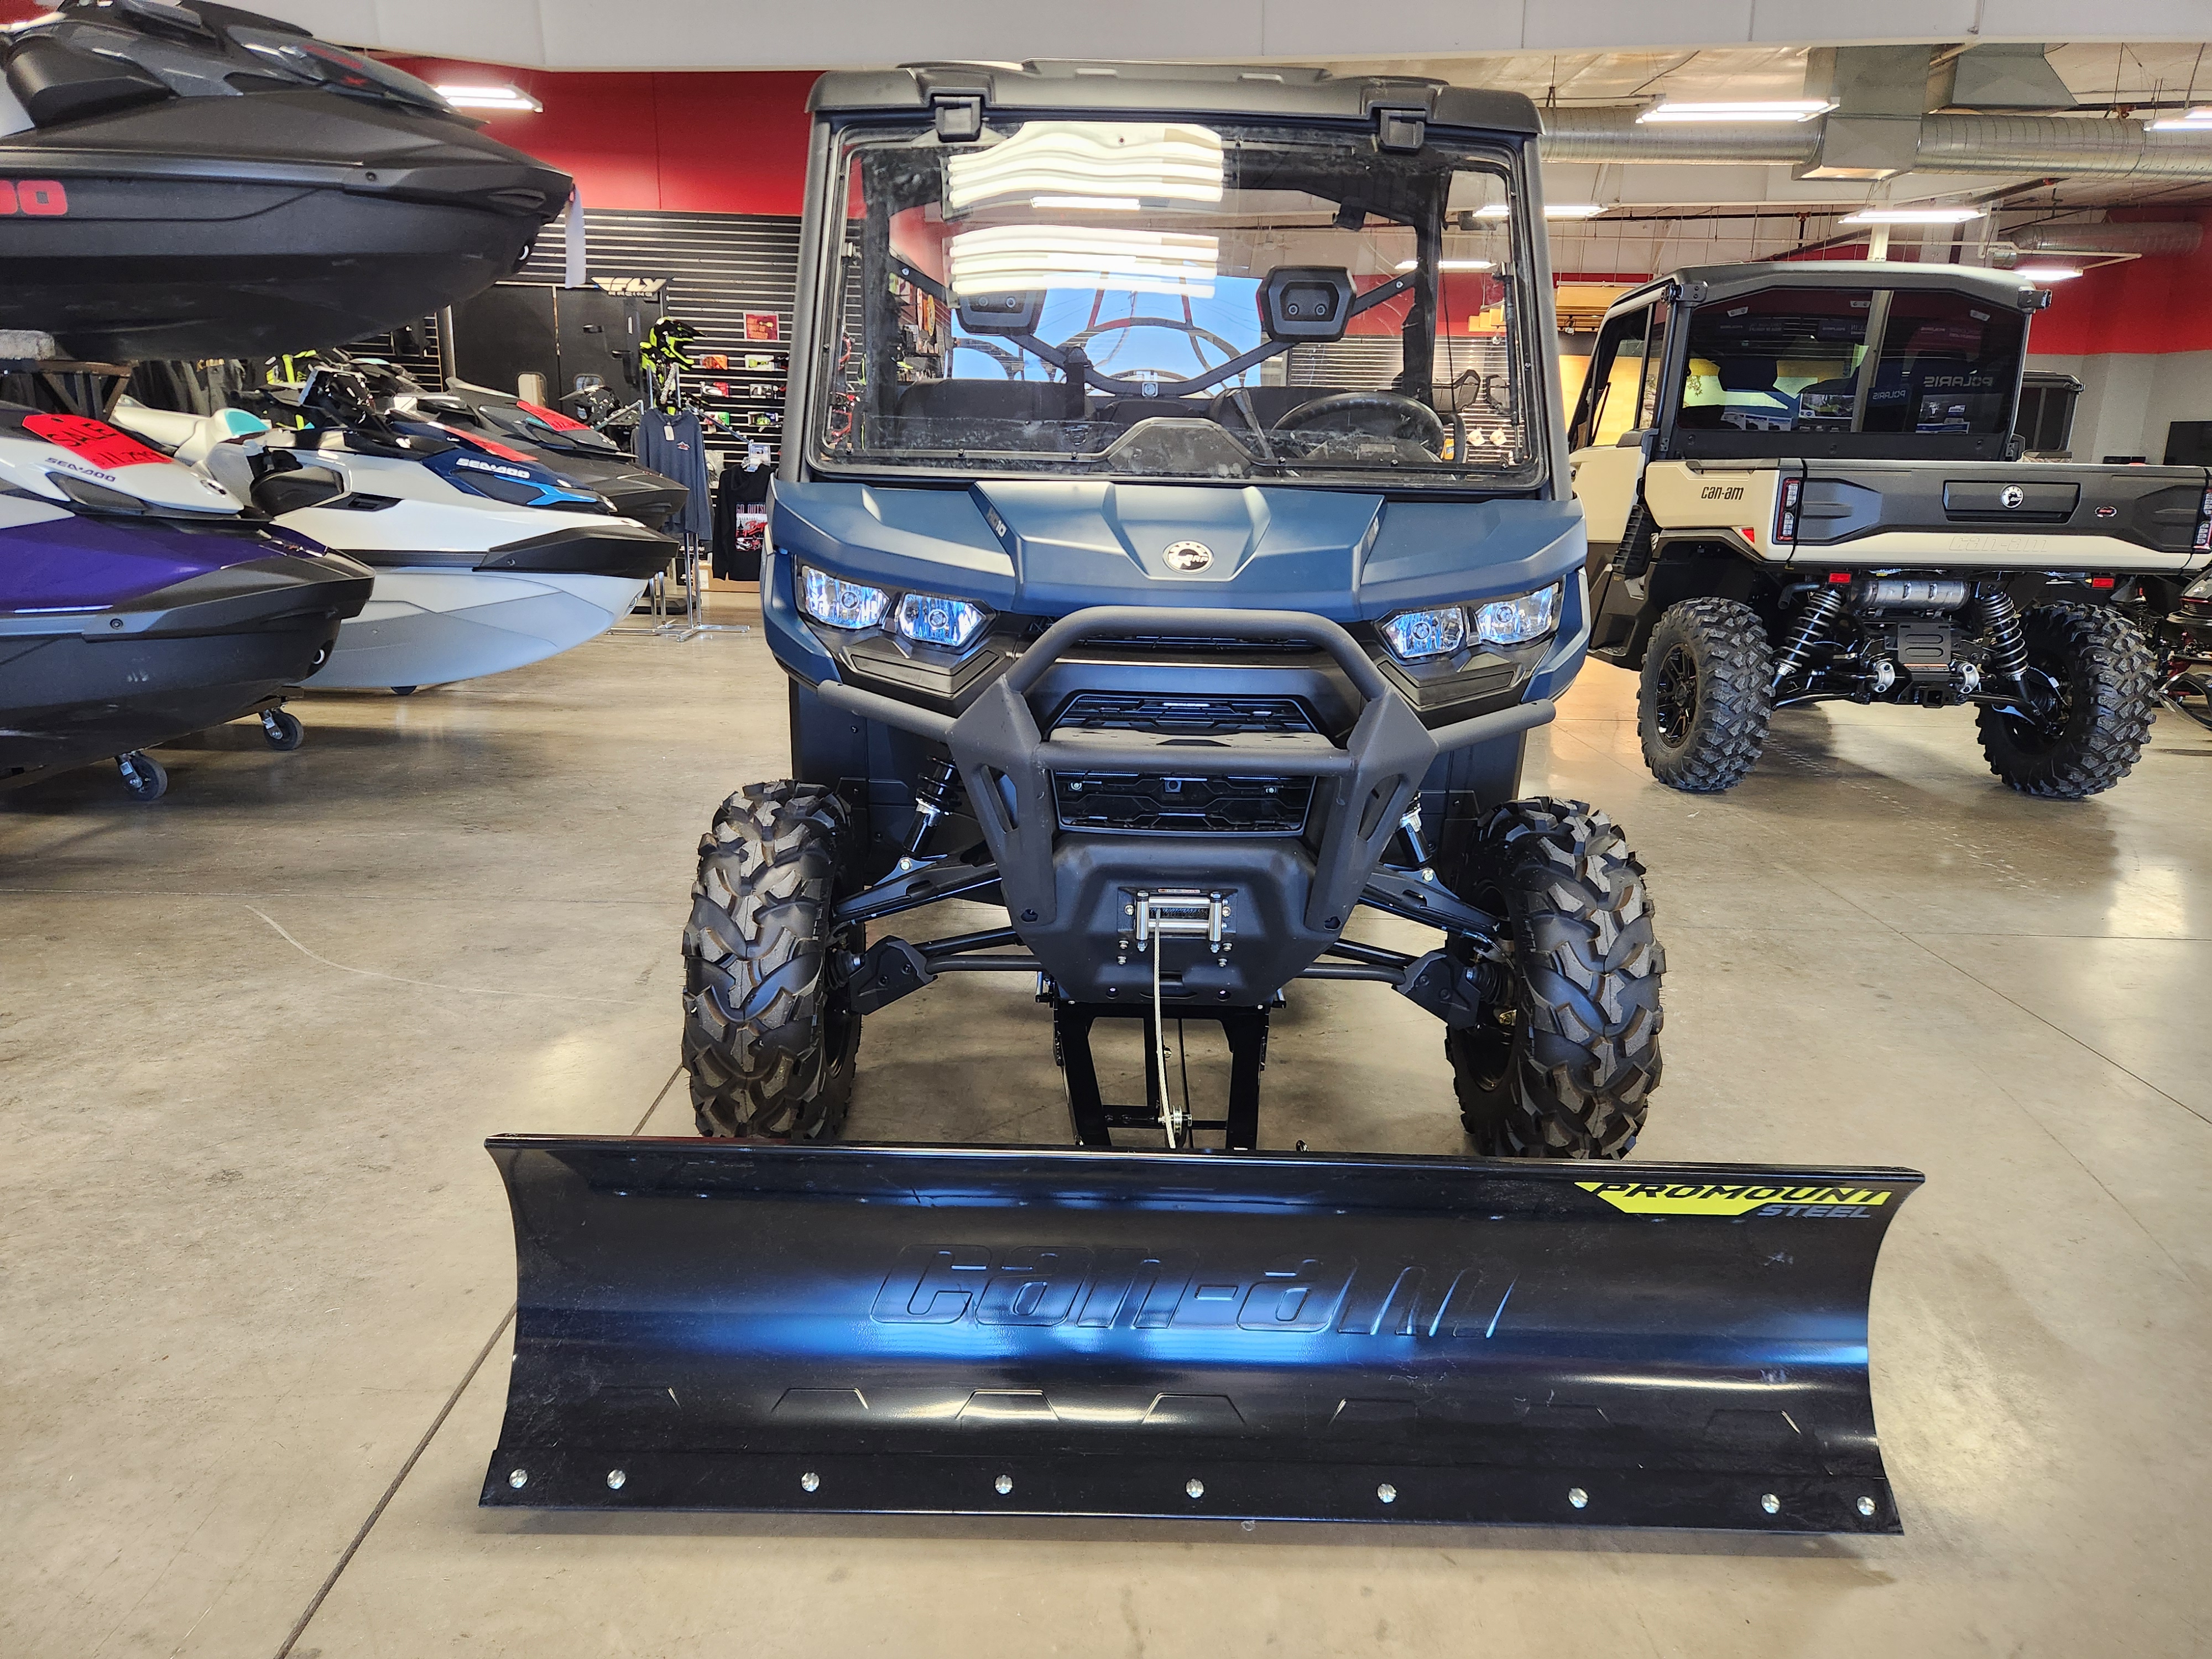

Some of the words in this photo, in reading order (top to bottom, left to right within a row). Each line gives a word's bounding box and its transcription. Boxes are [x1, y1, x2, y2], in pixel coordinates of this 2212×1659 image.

[596, 277, 667, 291] FLY
[46, 423, 118, 447] SALE
[736, 504, 744, 514] GO
[748, 504, 765, 514] OUTSI
[1590, 1182, 1893, 1204] PROMOUNT
[1757, 1204, 1871, 1218] STEEL
